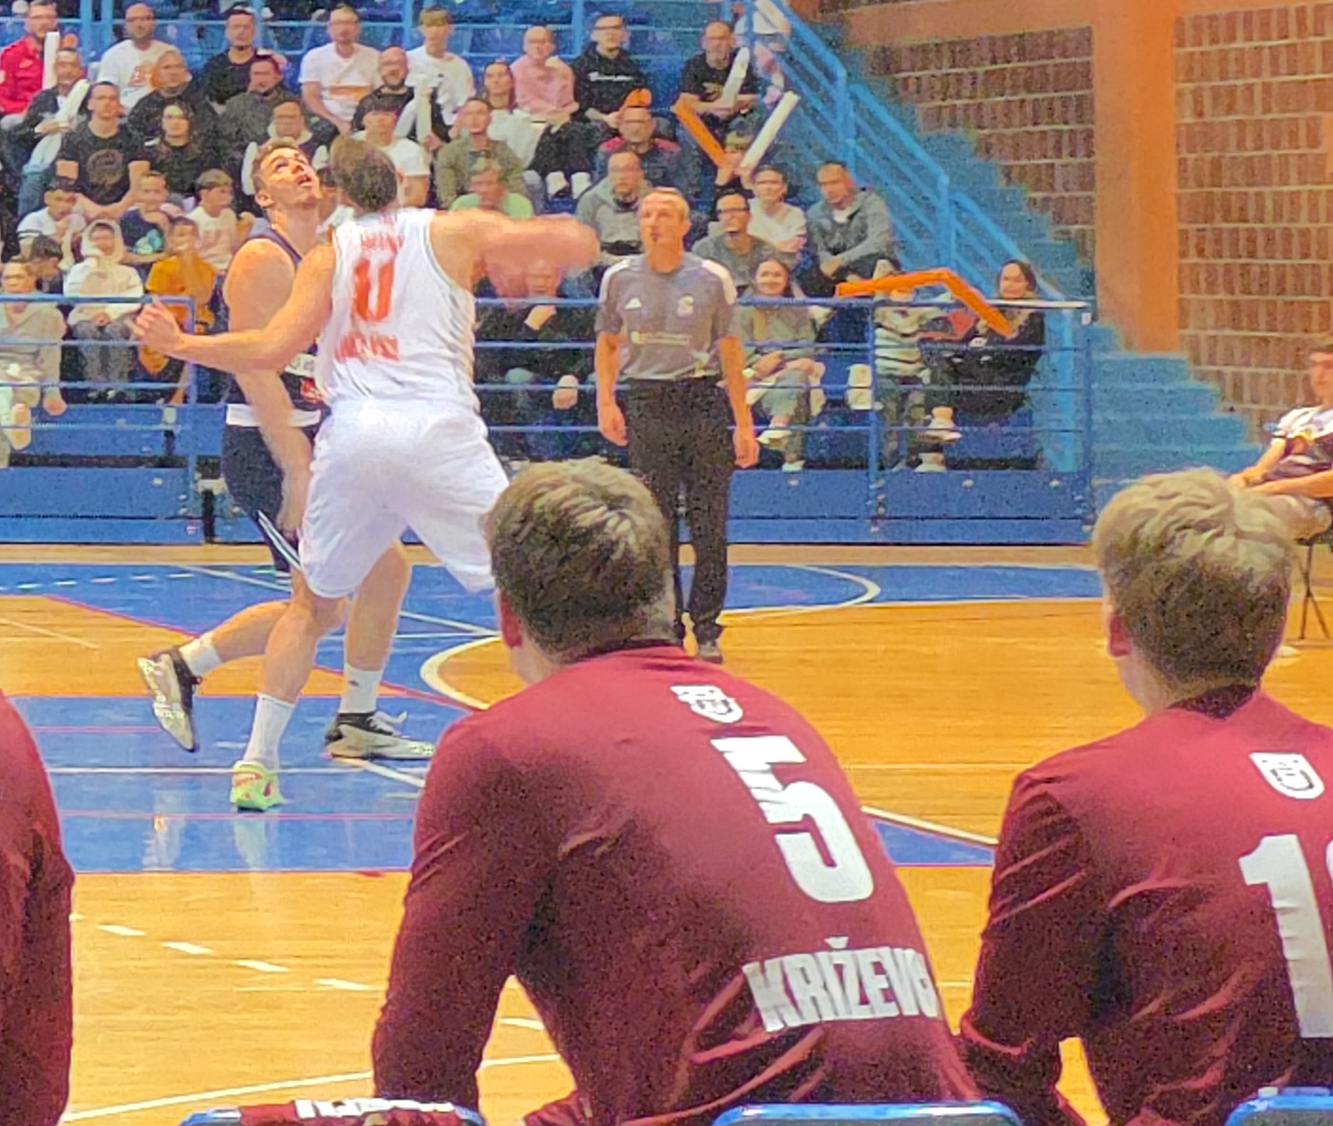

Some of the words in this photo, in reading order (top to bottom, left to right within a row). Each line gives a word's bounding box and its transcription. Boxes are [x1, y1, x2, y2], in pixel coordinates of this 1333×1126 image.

[710, 735, 874, 903] 5
[742, 935, 939, 1032] KRIŽEVC
[1238, 834, 1333, 1038] 1
